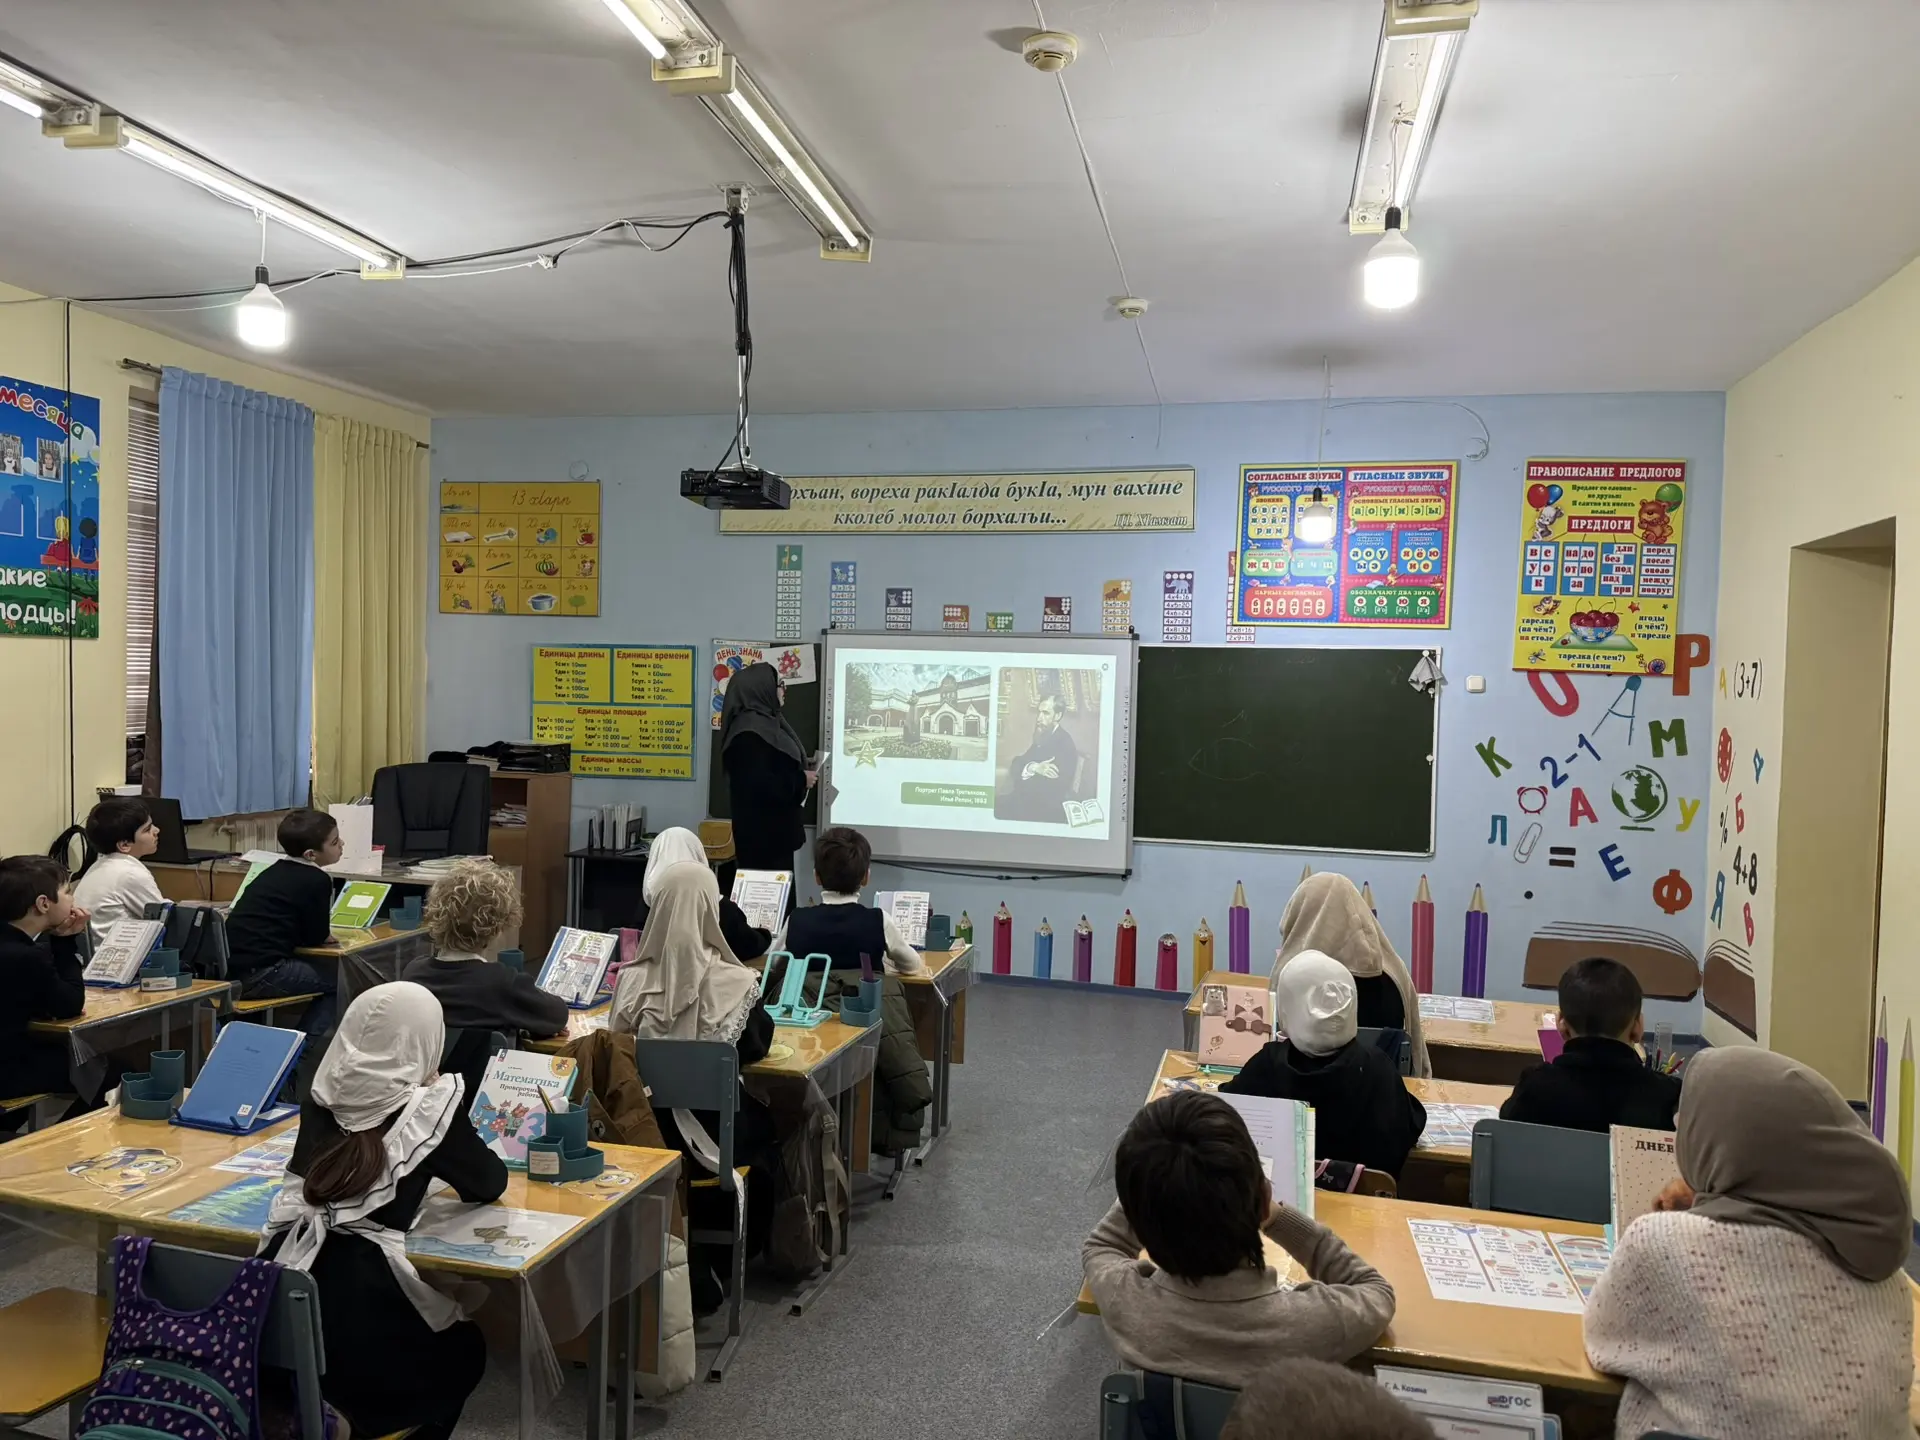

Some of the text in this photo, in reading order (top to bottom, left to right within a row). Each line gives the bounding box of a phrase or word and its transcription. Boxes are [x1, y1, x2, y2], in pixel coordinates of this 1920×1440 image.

[1248, 472, 1342, 481] СОГЛАСНЫЕ ЗВУКИ
[1353, 471, 1444, 480] ГЛАСНЫЕ ЗВУКИ
[1530, 466, 1682, 479] ПРАВОПИСАНИЕ ПРЕДЛОГОВ
[512, 490, 527, 505] 13
[791, 487, 845, 501] охъан,
[850, 486, 911, 503] вореха
[1068, 482, 1107, 501] мун
[1113, 482, 1183, 496] вахине
[834, 509, 896, 525] кколеб
[898, 512, 957, 525] молол
[1571, 519, 1632, 531] ПРЕДЛОГИ
[1529, 548, 1551, 557] в с
[1565, 549, 1594, 559] на до
[1645, 547, 1671, 555] перед
[1604, 553, 1621, 563] без
[1528, 563, 1551, 574] у о
[1615, 566, 1632, 574] под
[1534, 579, 1543, 587] к
[1571, 580, 1583, 588] за
[1603, 575, 1620, 584] над
[1642, 577, 1670, 585] между
[1637, 632, 1671, 640] тарелке
[539, 648, 605, 660] Единицы длины
[616, 650, 689, 662] Единицы времени
[716, 648, 737, 662] ДЕНЬ
[1558, 652, 1592, 661] тарелка
[1576, 662, 1612, 670] ягодами
[1672, 633, 1711, 696] Р
[577, 707, 647, 717] Единицы площади
[1648, 718, 1688, 758] М
[581, 755, 614, 764] Единицы
[1475, 736, 1512, 778] К
[1569, 787, 1599, 827] А
[1488, 814, 1508, 846] Л
[1598, 843, 1632, 882] Е
[1652, 868, 1692, 915] Ф
[492, 1070, 561, 1088] Математика
[499, 1083, 540, 1094] Проверочны
[1635, 1140, 1675, 1153] ДНЕВ
